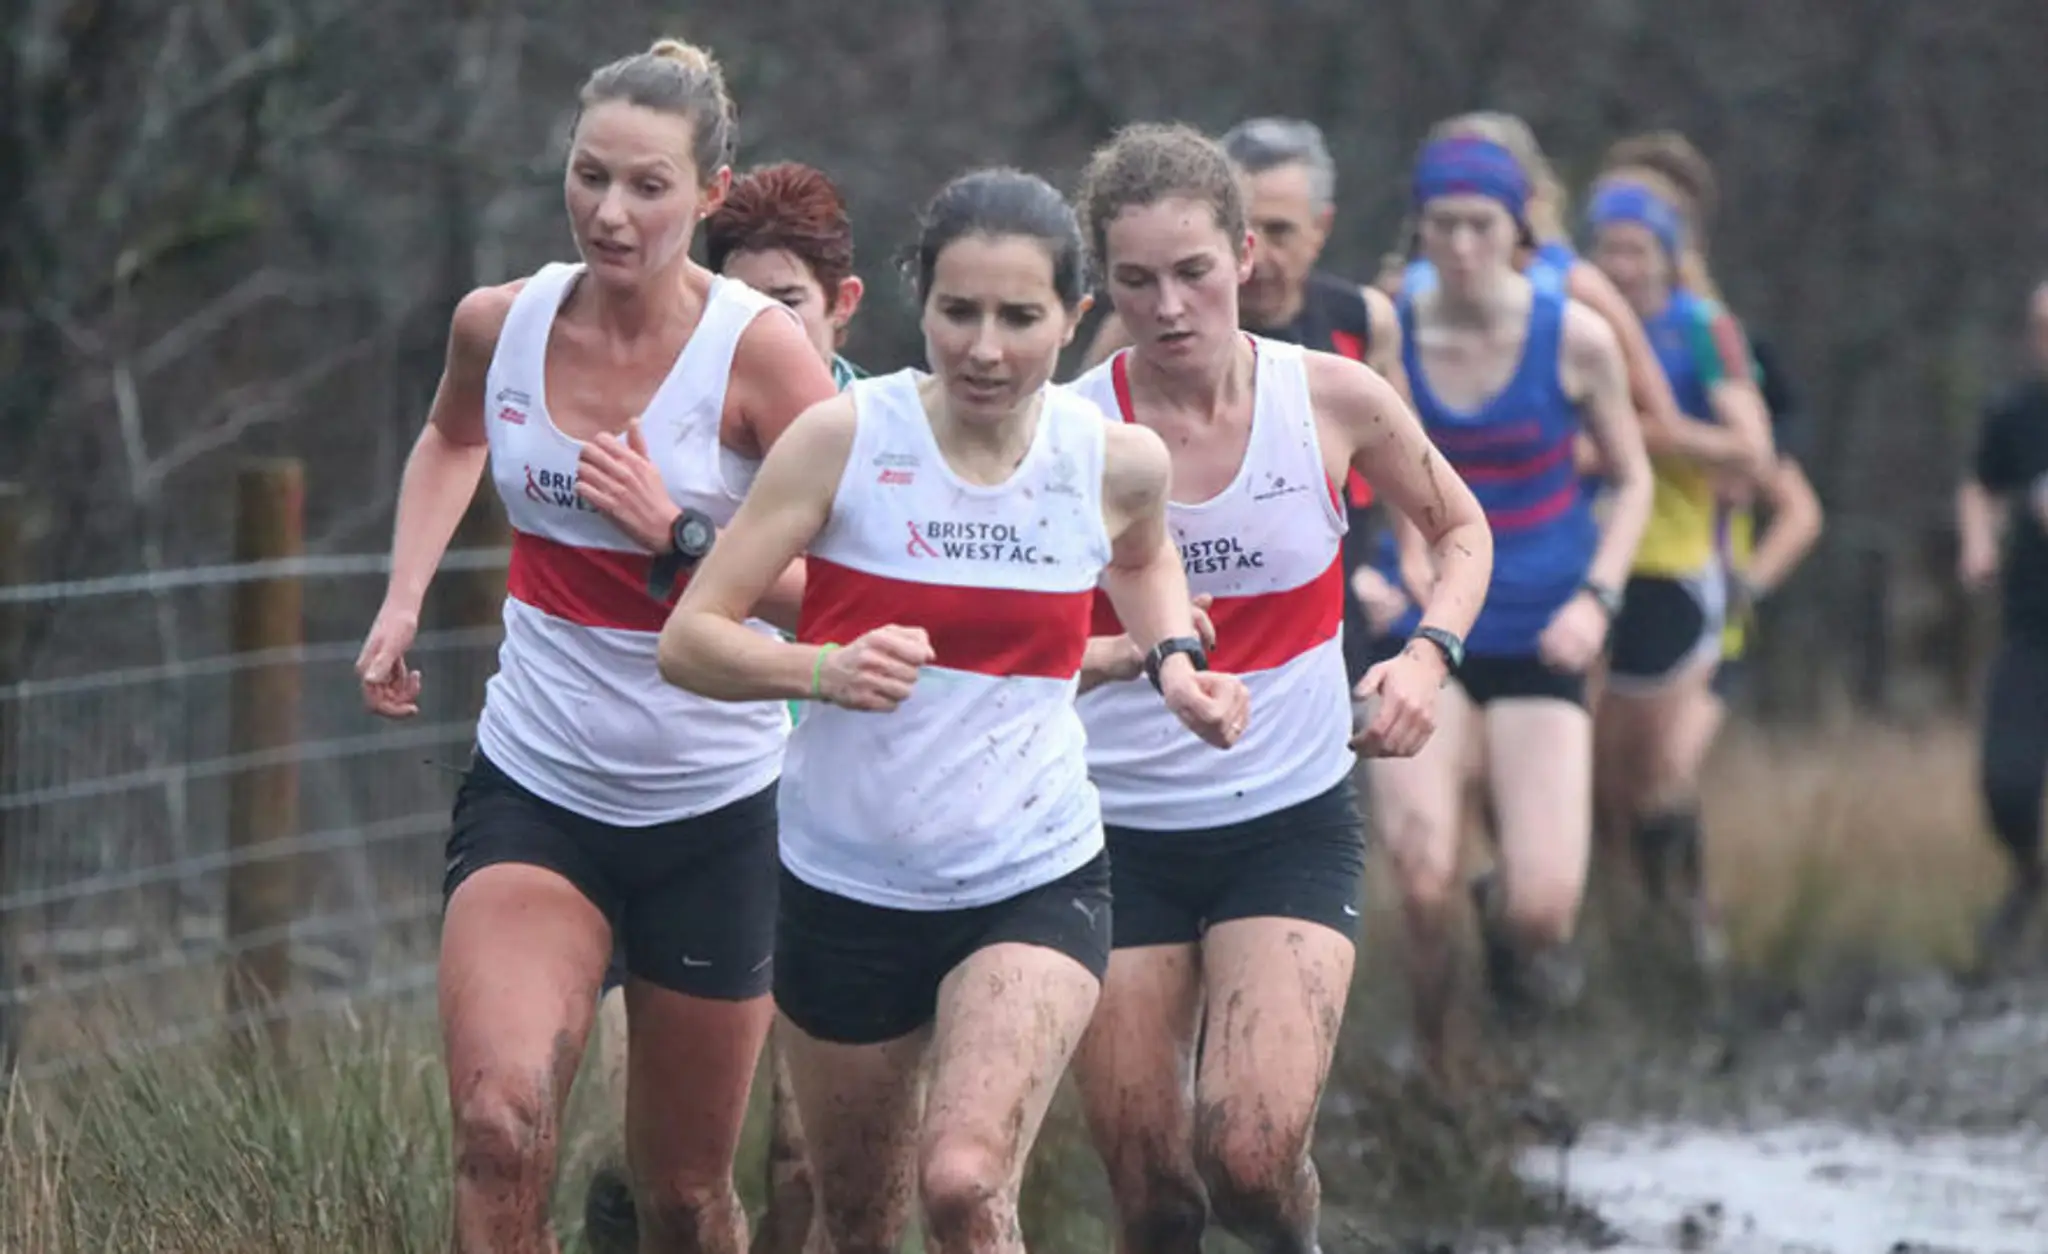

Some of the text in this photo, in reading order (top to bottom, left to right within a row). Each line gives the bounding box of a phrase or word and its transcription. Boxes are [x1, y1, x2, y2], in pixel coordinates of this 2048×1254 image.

[927, 521, 1021, 543] BRISTOL
[943, 542, 1038, 564] WEST AC
[1177, 537, 1244, 559] ISTOL
[1236, 551, 1264, 569] AC
